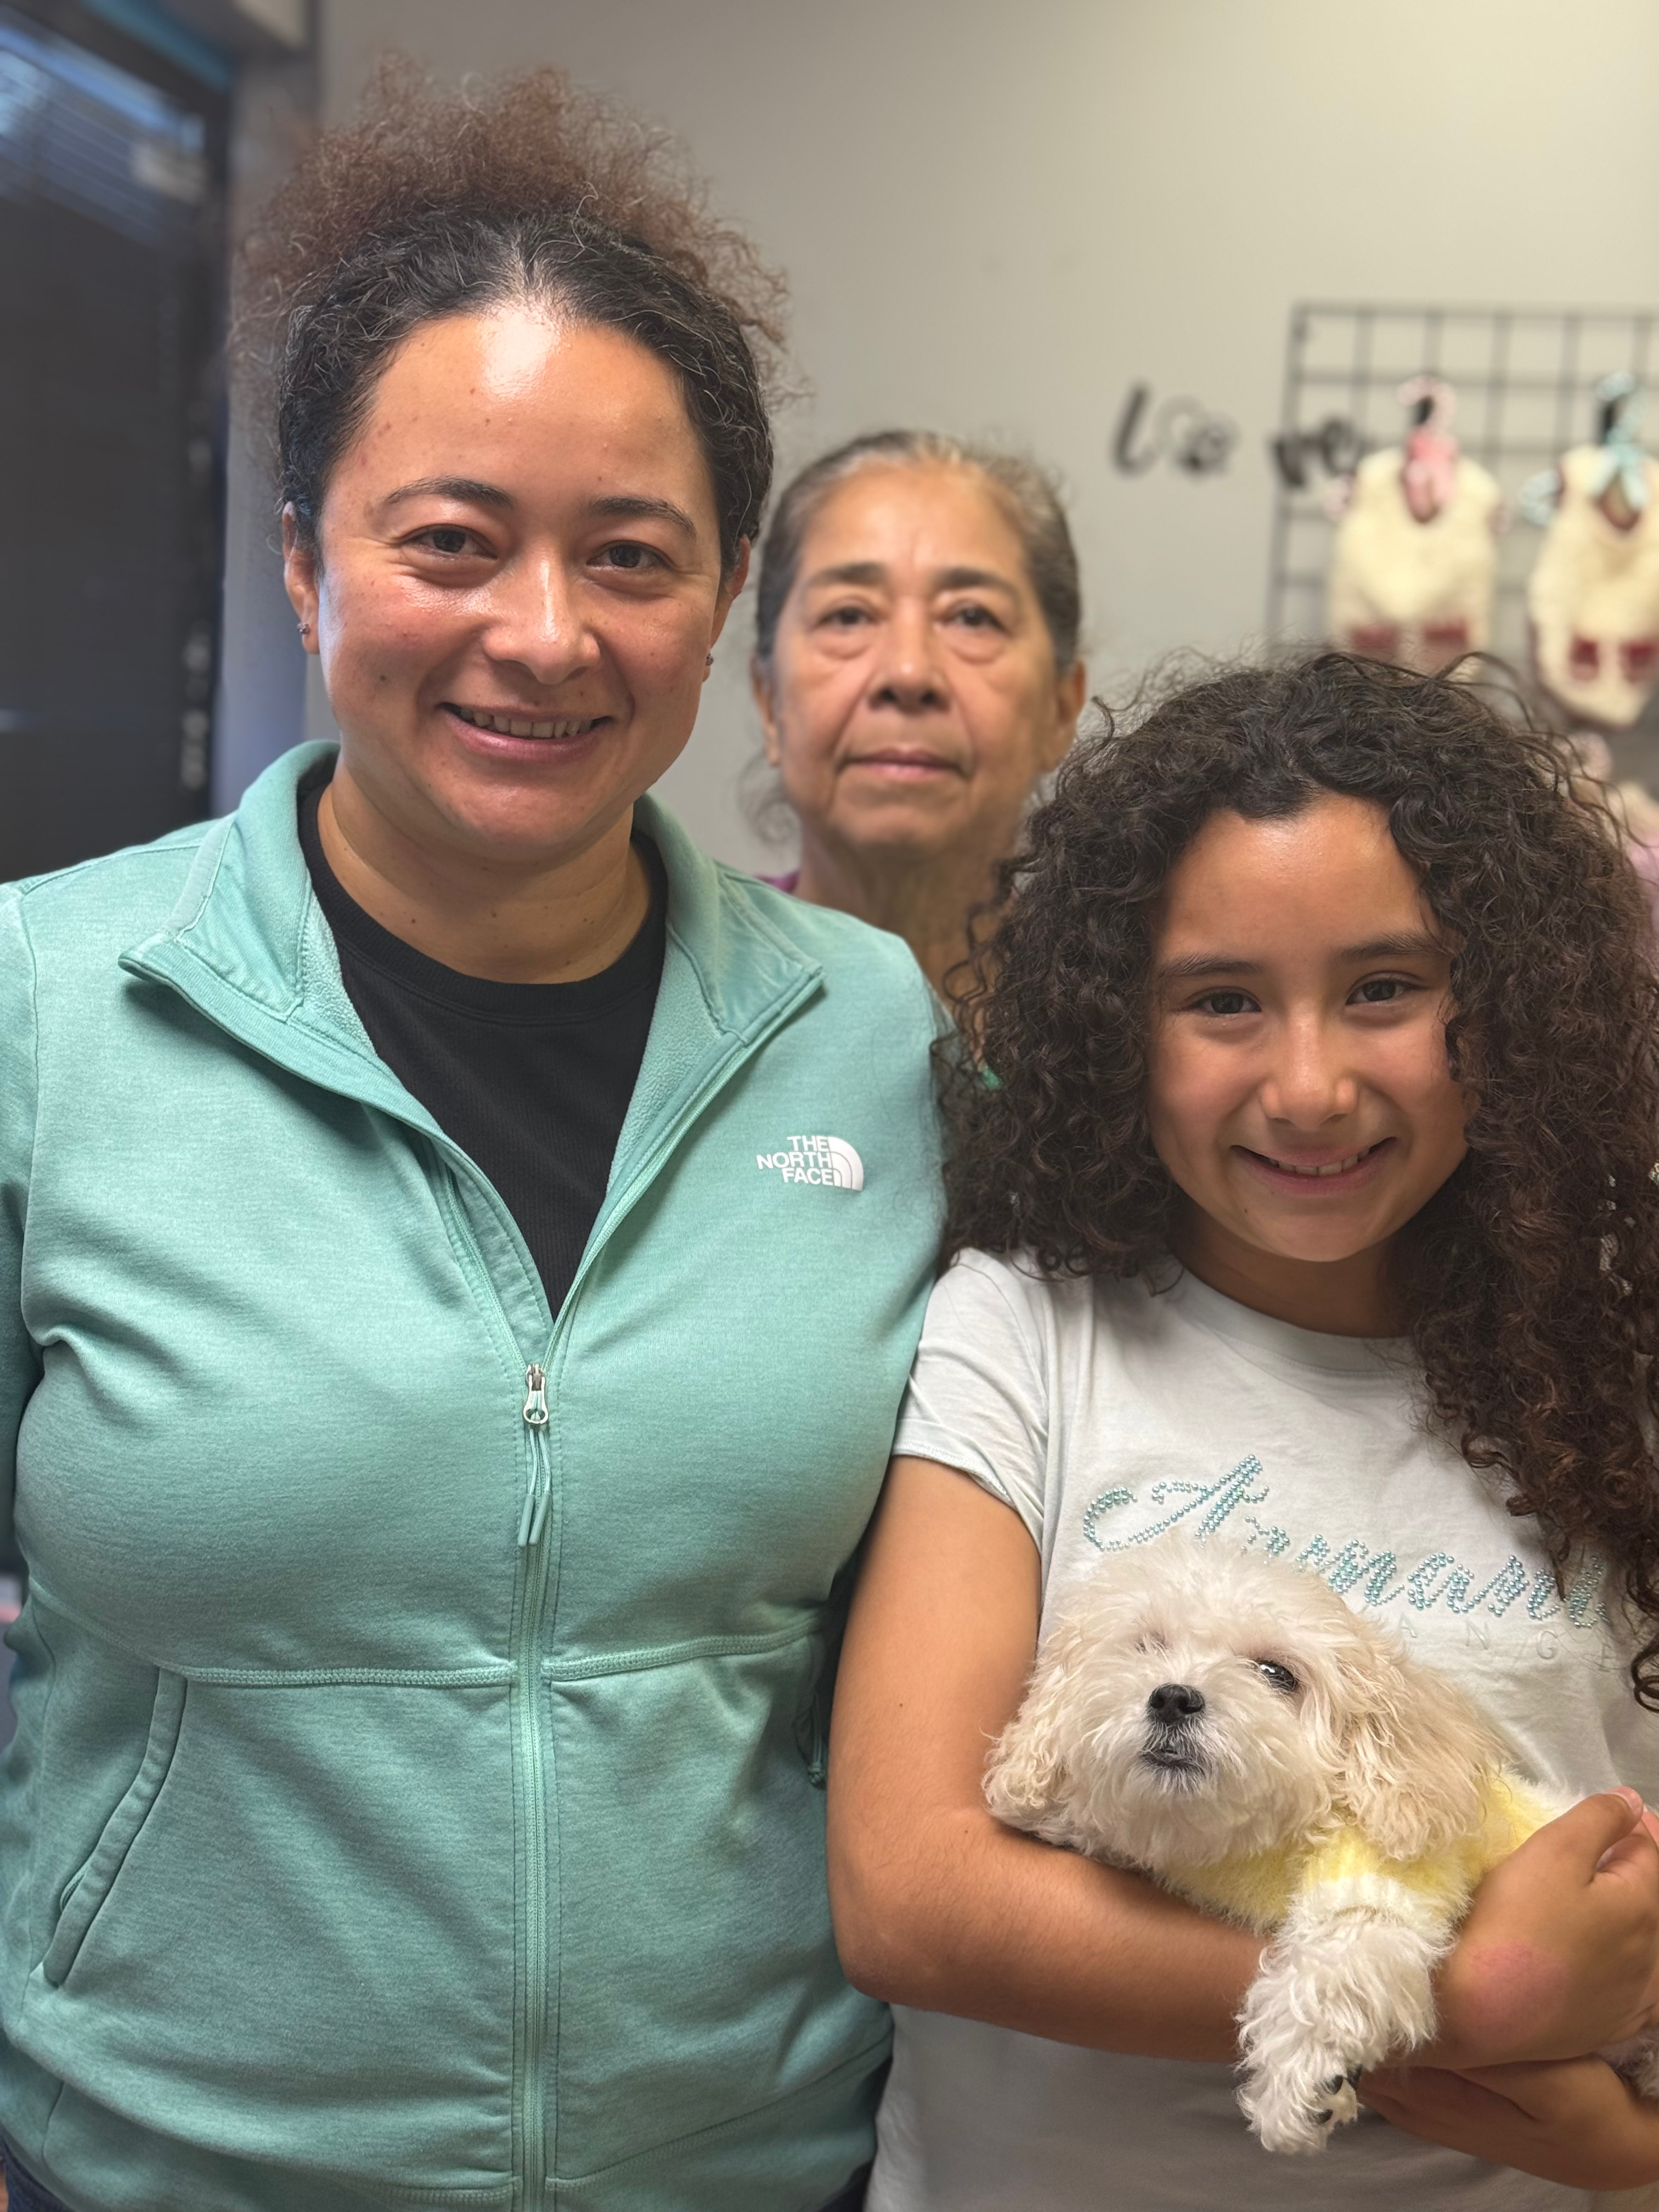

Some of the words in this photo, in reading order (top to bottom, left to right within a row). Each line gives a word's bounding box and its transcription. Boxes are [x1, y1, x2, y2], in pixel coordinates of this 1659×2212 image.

[787, 1135, 830, 1152] THE
[756, 1152, 833, 1170] NORTH
[782, 1167, 834, 1186] FACE
